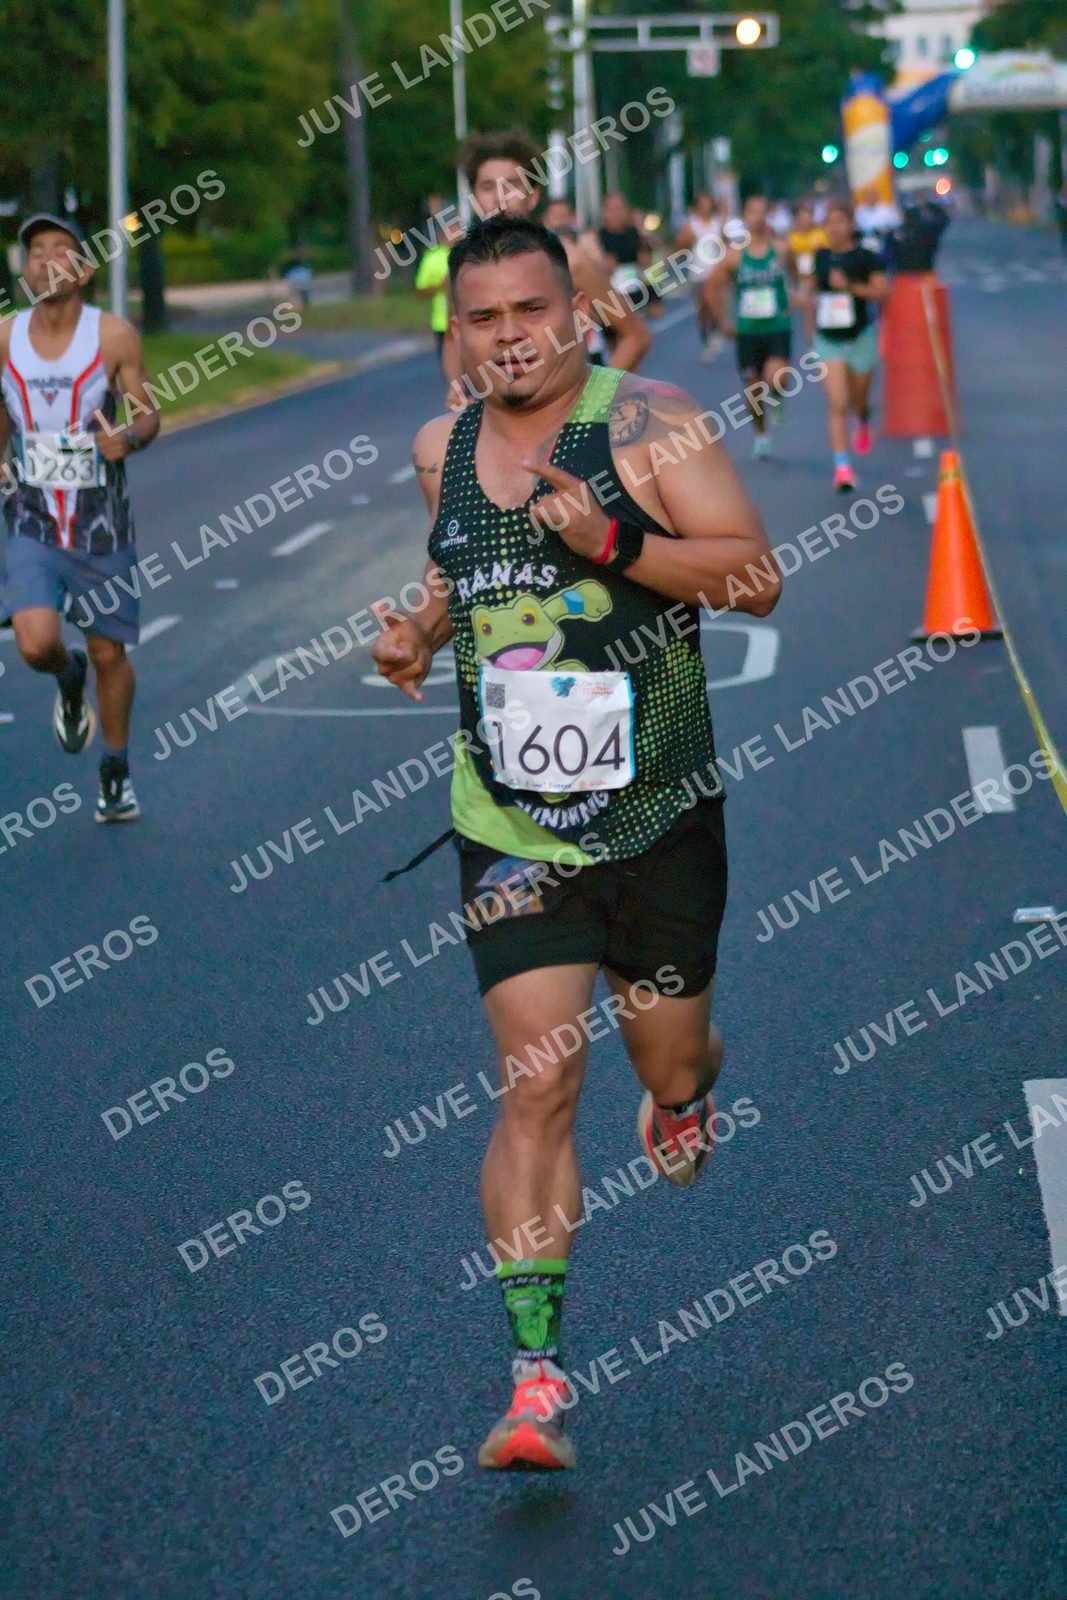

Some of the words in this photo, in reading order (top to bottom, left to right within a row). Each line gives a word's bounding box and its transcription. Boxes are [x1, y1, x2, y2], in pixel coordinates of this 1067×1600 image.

[28, 457, 95, 482] 1263
[456, 562, 558, 606] RANAS
[492, 719, 626, 776] 1604
